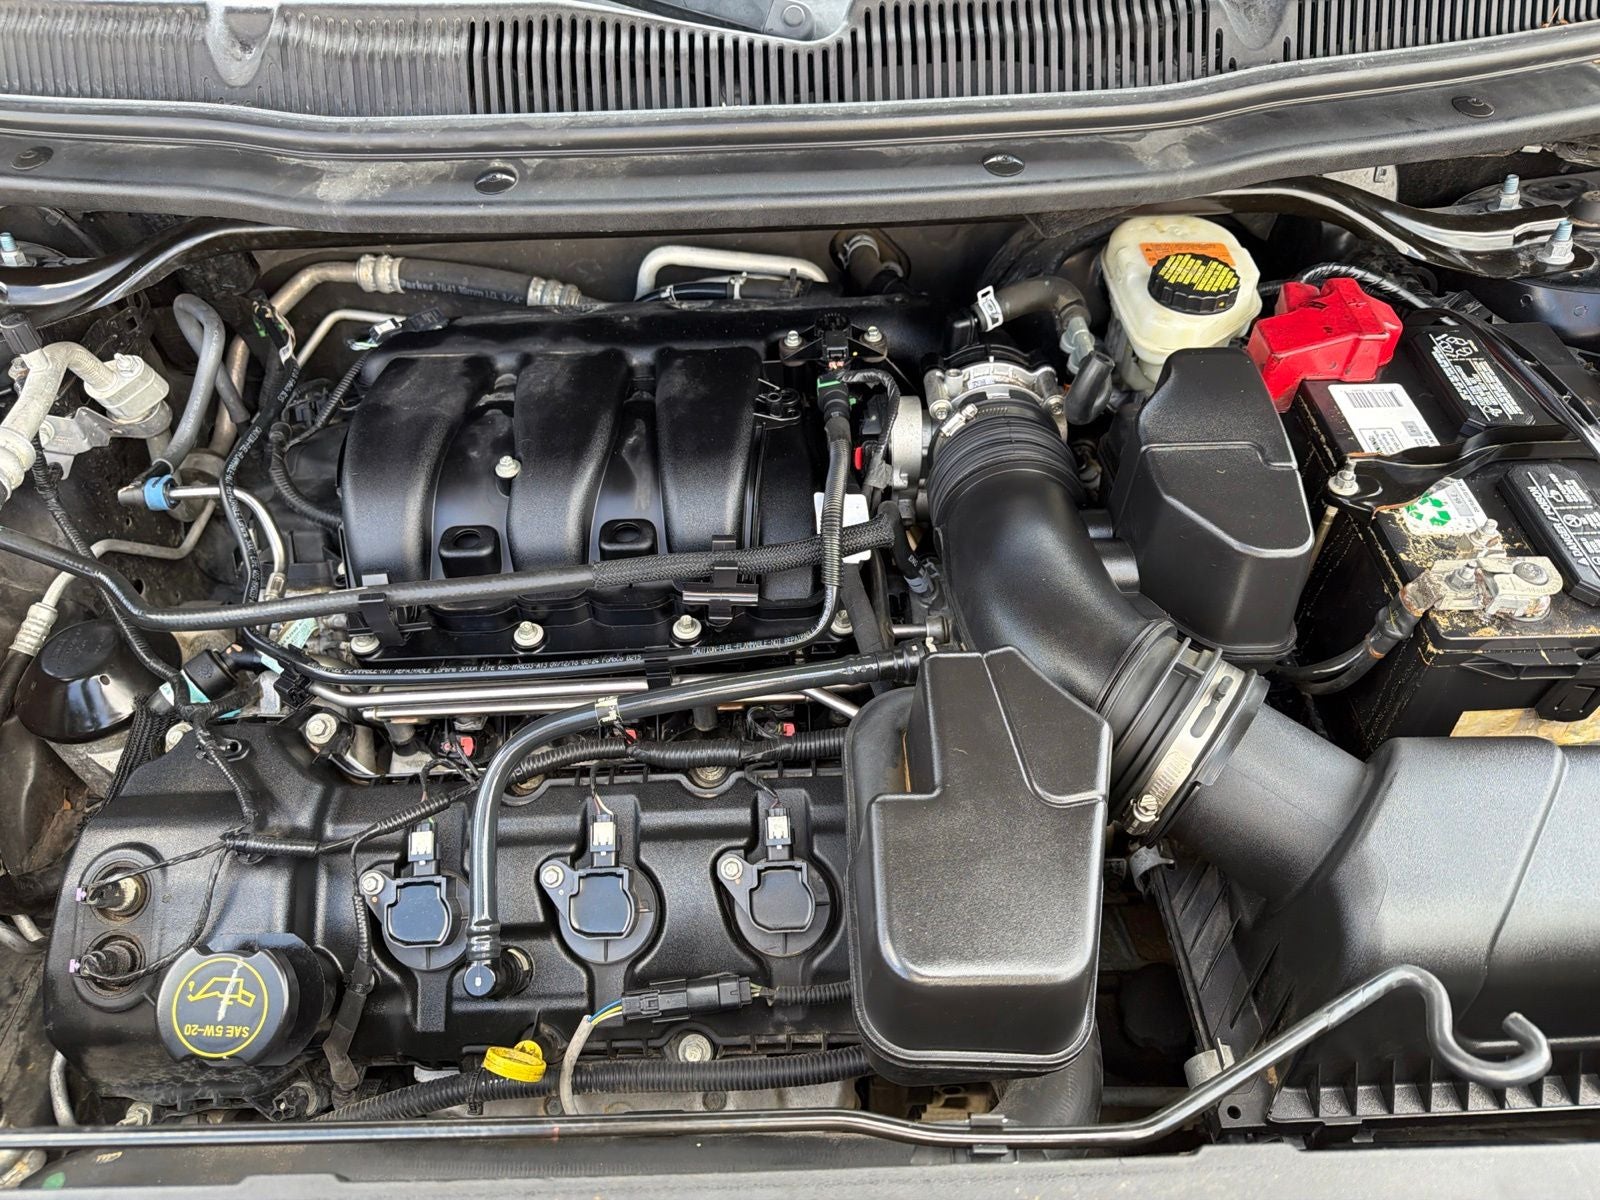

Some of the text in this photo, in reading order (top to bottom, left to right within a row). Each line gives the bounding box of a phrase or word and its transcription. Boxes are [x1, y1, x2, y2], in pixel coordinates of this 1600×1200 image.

[1527, 486, 1555, 516] POISON
[1553, 522, 1583, 557] DANGER
[184, 1023, 250, 1038] SAE 5W-20
